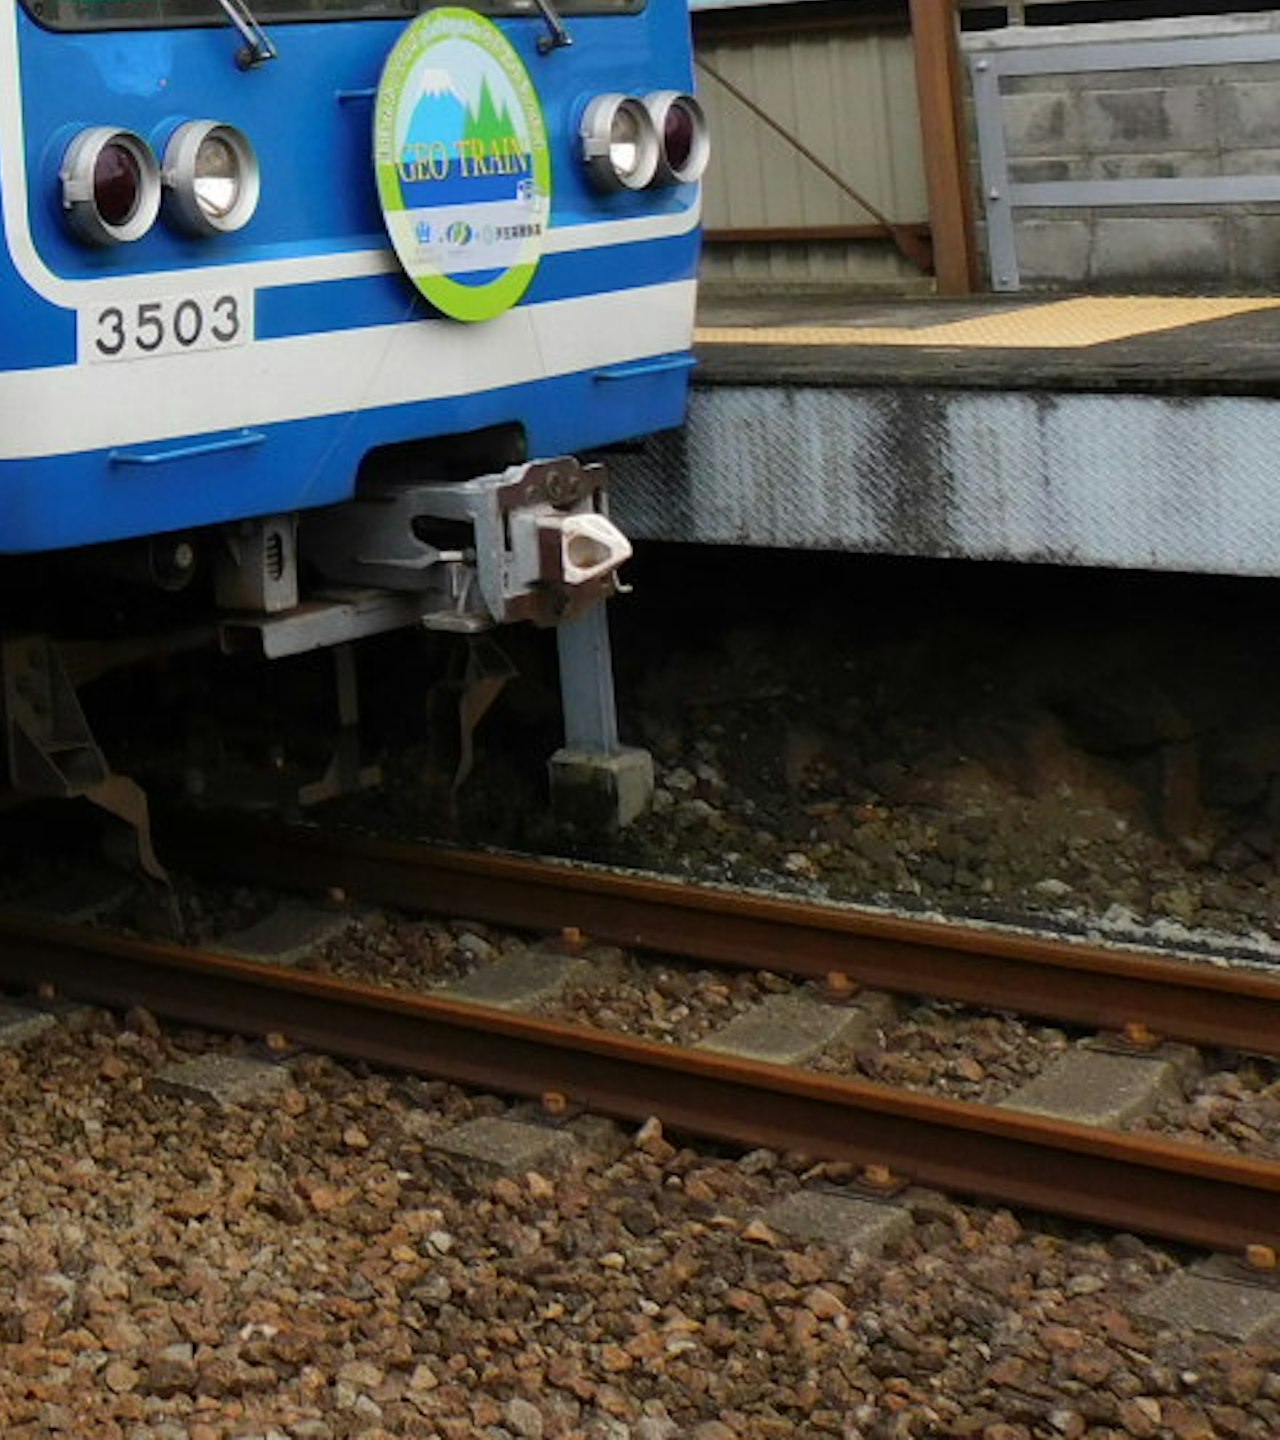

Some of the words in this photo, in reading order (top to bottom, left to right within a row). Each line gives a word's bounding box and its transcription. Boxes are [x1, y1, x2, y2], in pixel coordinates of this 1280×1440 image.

[400, 141, 449, 182] GEO
[454, 138, 528, 178] TRAIN
[95, 294, 240, 355] 3503
